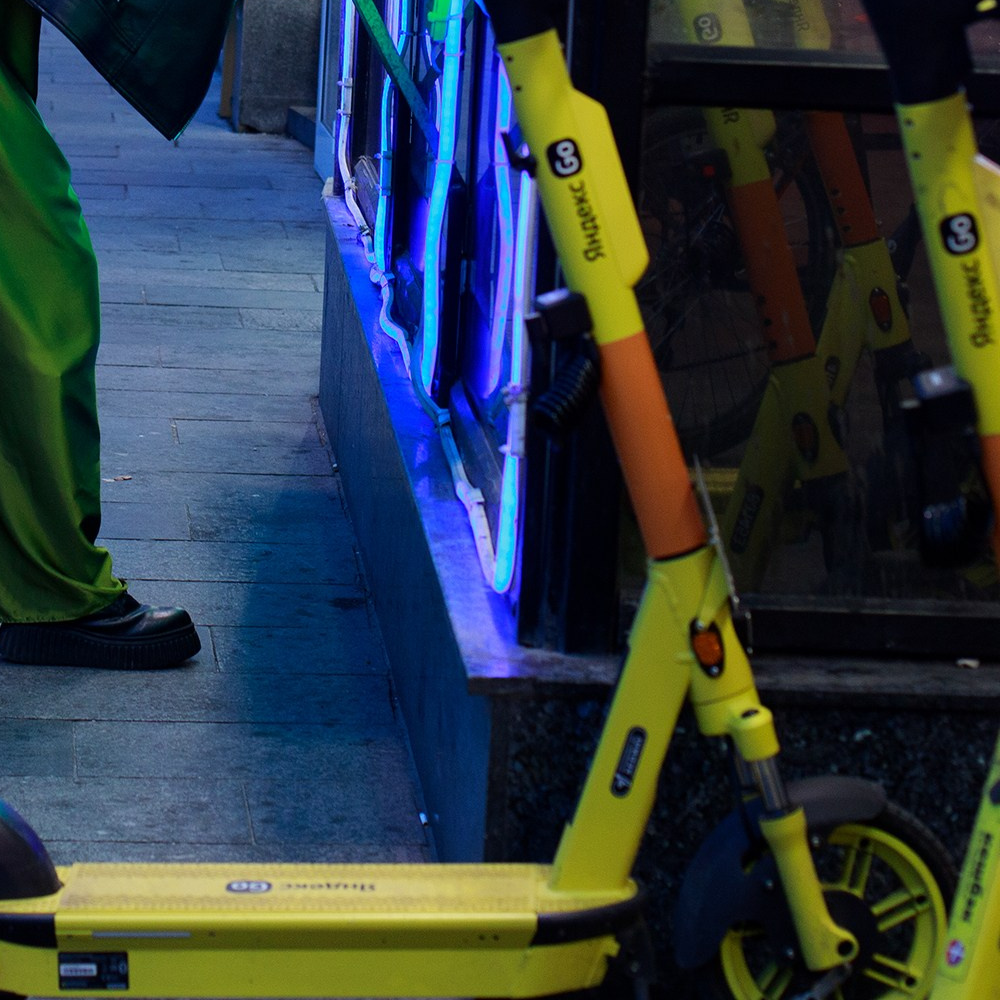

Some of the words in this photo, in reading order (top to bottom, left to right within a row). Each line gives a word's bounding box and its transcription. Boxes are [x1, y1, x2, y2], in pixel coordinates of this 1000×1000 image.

[552, 139, 581, 177] Go
[568, 179, 606, 262] Яндекс
[945, 213, 977, 254] Go
[961, 260, 994, 348] Яндекс
